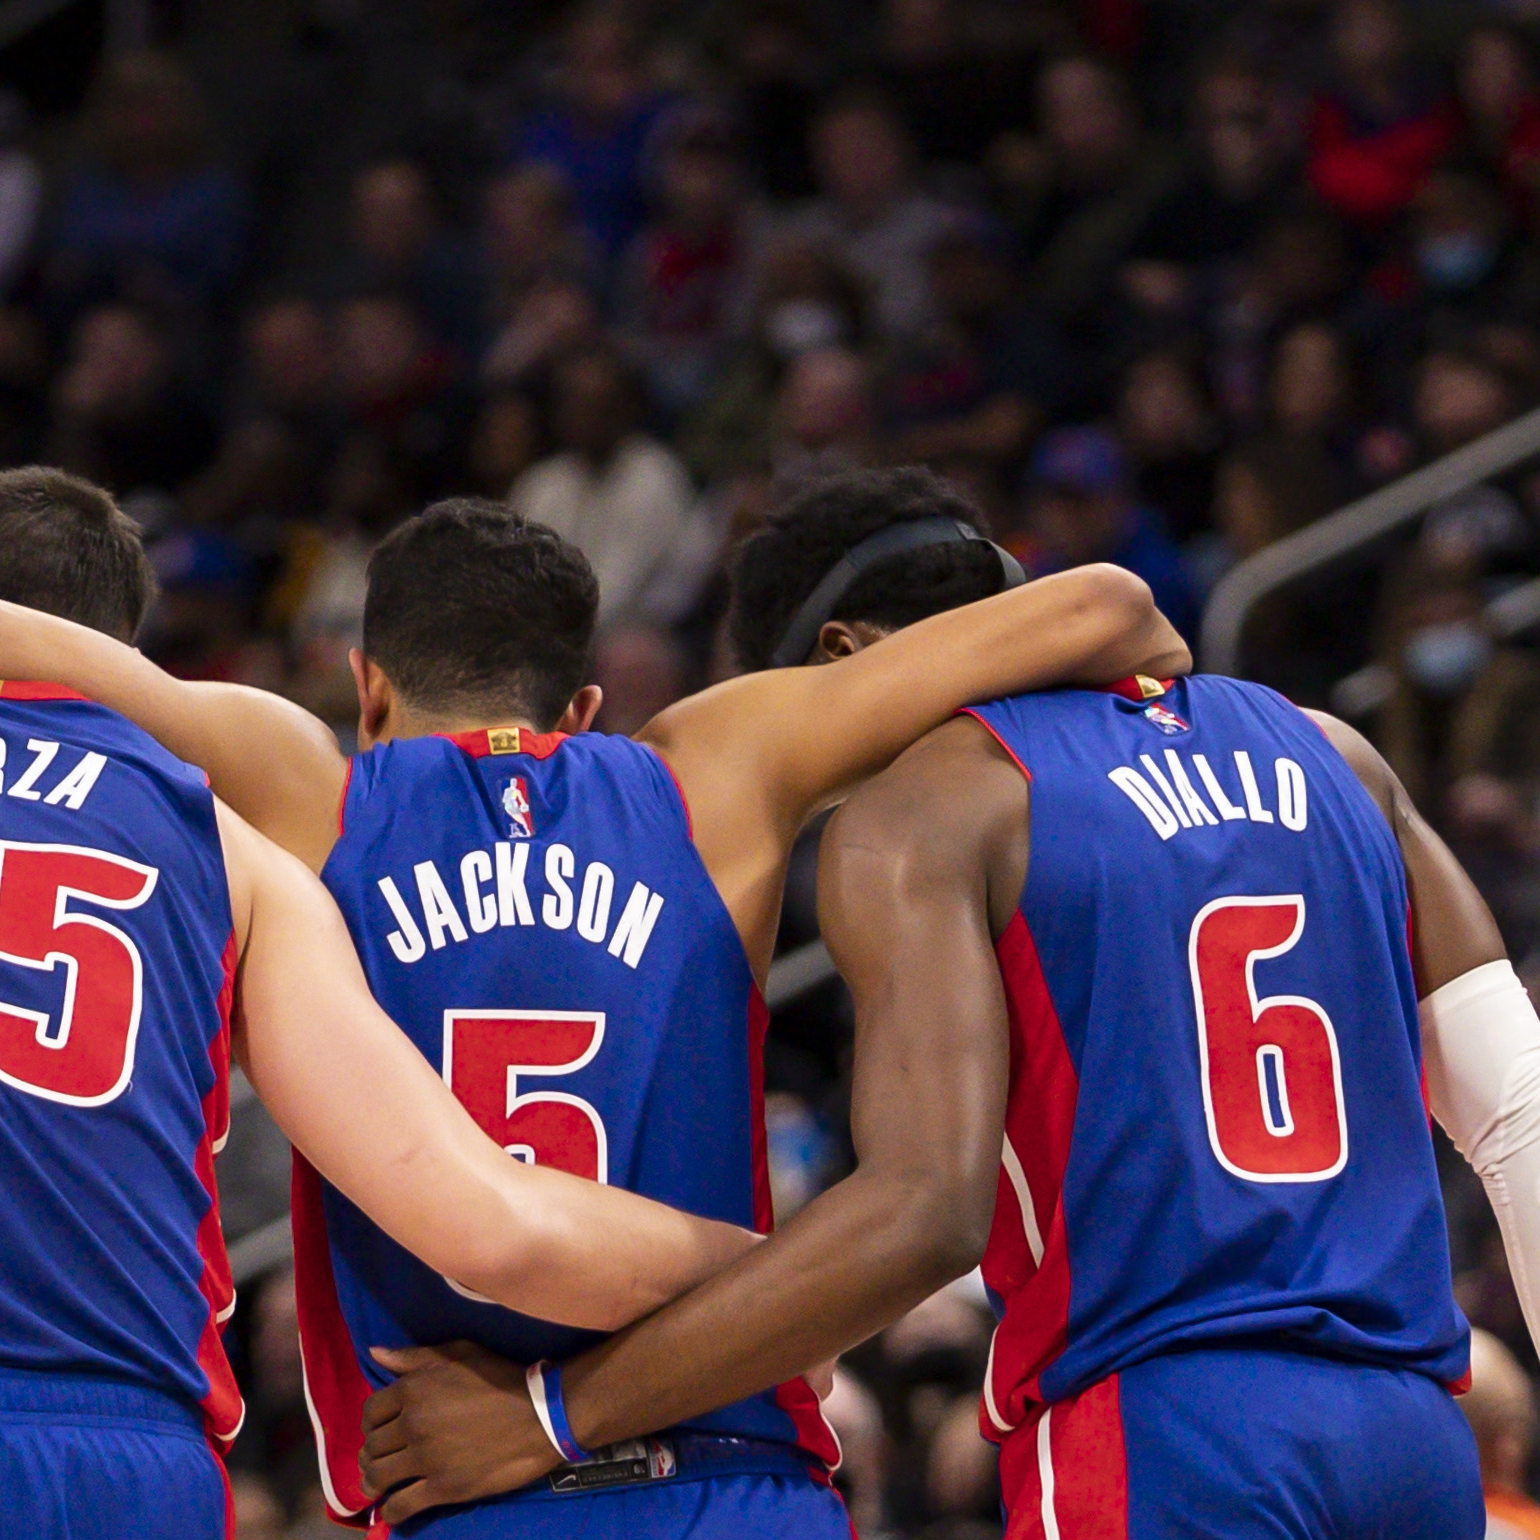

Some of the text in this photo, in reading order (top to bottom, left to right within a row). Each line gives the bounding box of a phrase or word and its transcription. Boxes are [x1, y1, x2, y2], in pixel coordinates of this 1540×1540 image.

[1108, 749, 1307, 841] DIALLO
[377, 842, 664, 970] JACKSON
[442, 1009, 607, 1186] 5
[1188, 894, 1349, 1183] 6
